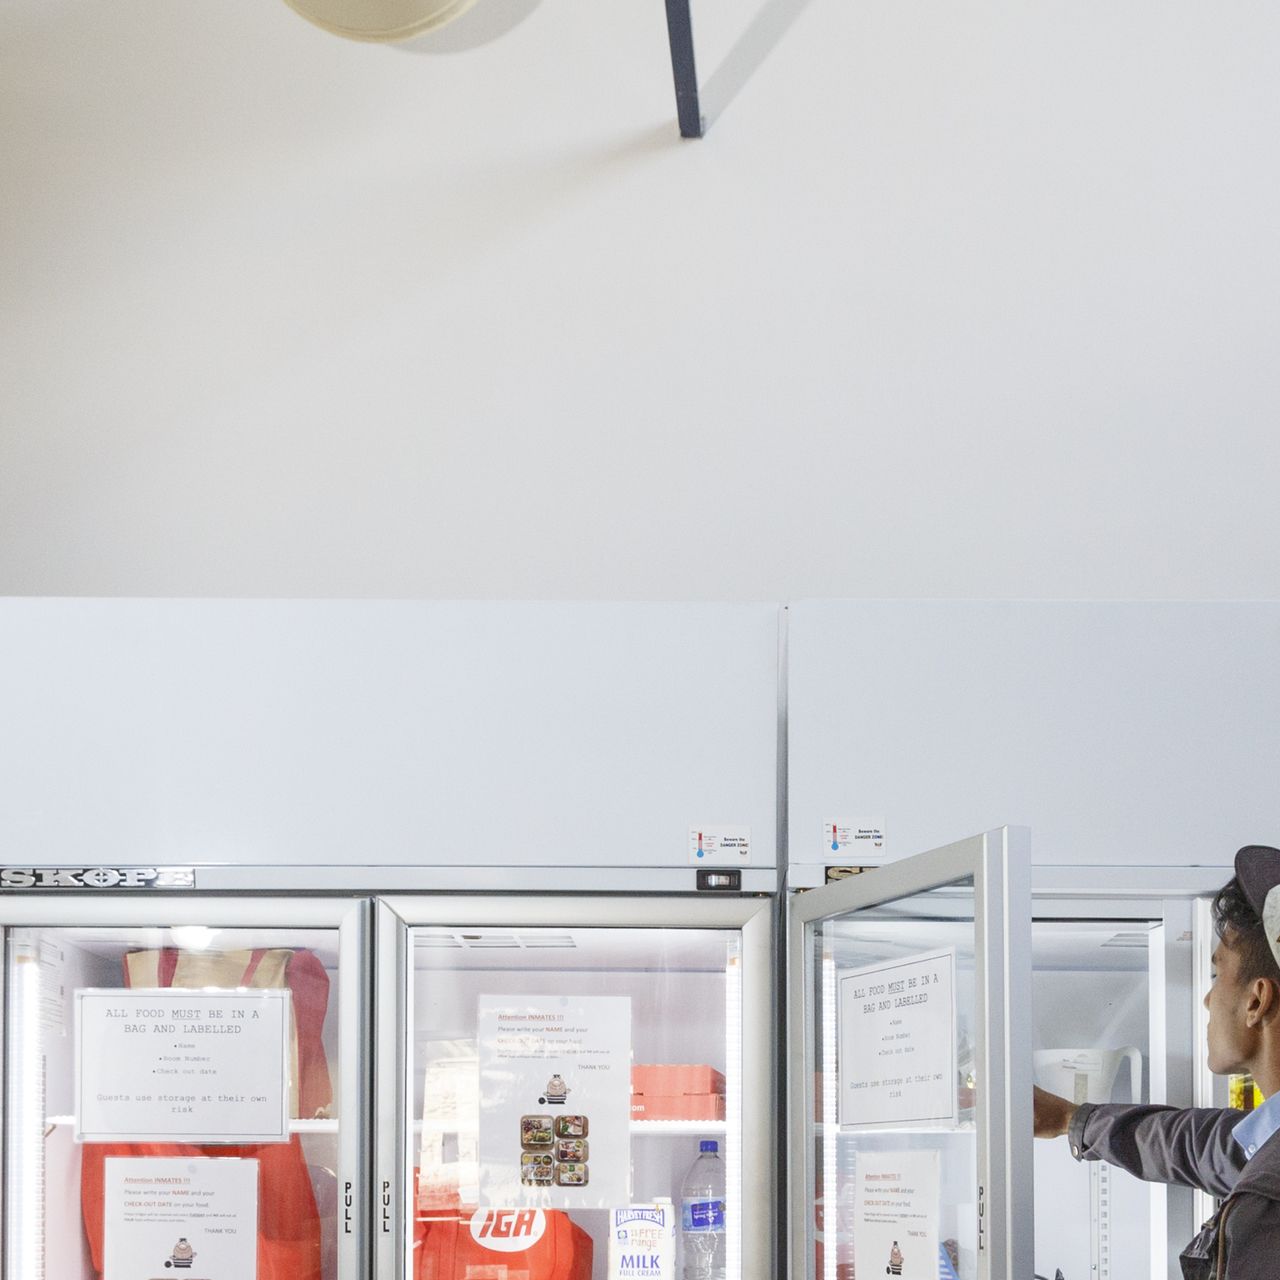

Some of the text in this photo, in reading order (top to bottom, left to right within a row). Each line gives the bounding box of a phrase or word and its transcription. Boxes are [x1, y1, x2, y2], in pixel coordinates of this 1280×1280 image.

[0, 868, 195, 888] SKOPE
[853, 974, 939, 999] ALL FOOD MUST BE IN A
[864, 993, 928, 1014] BAG AND LABELLED
[106, 1009, 260, 1020] ALL FOOD MUST BE IN A
[124, 1024, 242, 1034] BAG AND LABELLED
[158, 1095, 196, 1104] storage
[217, 1094, 245, 1102] their
[479, 1208, 536, 1238] IGA
[621, 1255, 660, 1269] MILK
